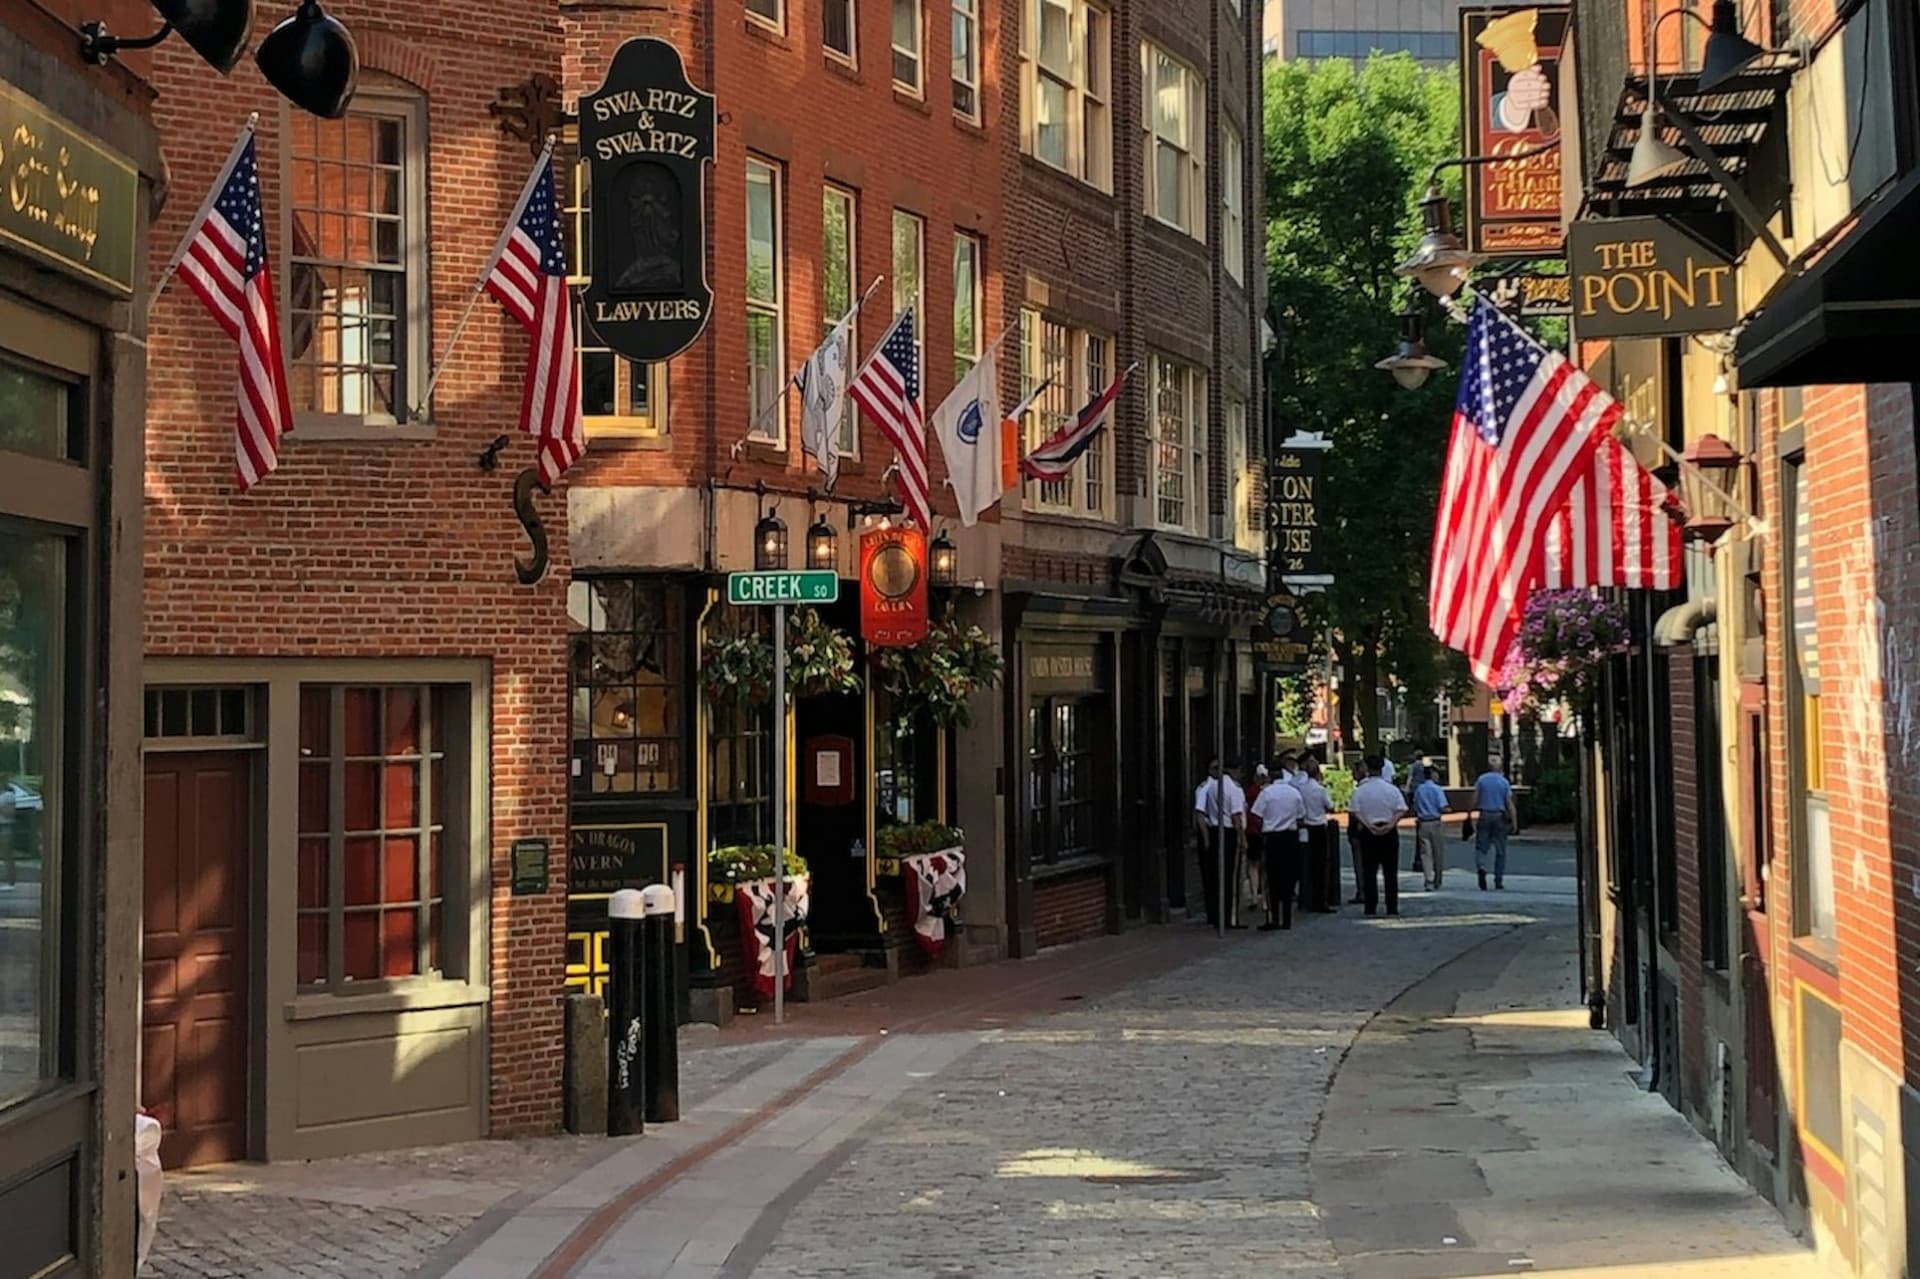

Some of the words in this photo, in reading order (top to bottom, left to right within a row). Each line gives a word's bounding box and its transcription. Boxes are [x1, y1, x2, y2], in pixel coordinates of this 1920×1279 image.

[593, 88, 698, 120] SWARTZ
[638, 111, 655, 129] &
[596, 130, 698, 160] SWARTZ
[1594, 240, 1656, 270] THE
[1579, 256, 1730, 320] POINT
[596, 300, 701, 321] LAWYERS
[739, 575, 802, 600] CREEK
[572, 855, 624, 871] AVERN
